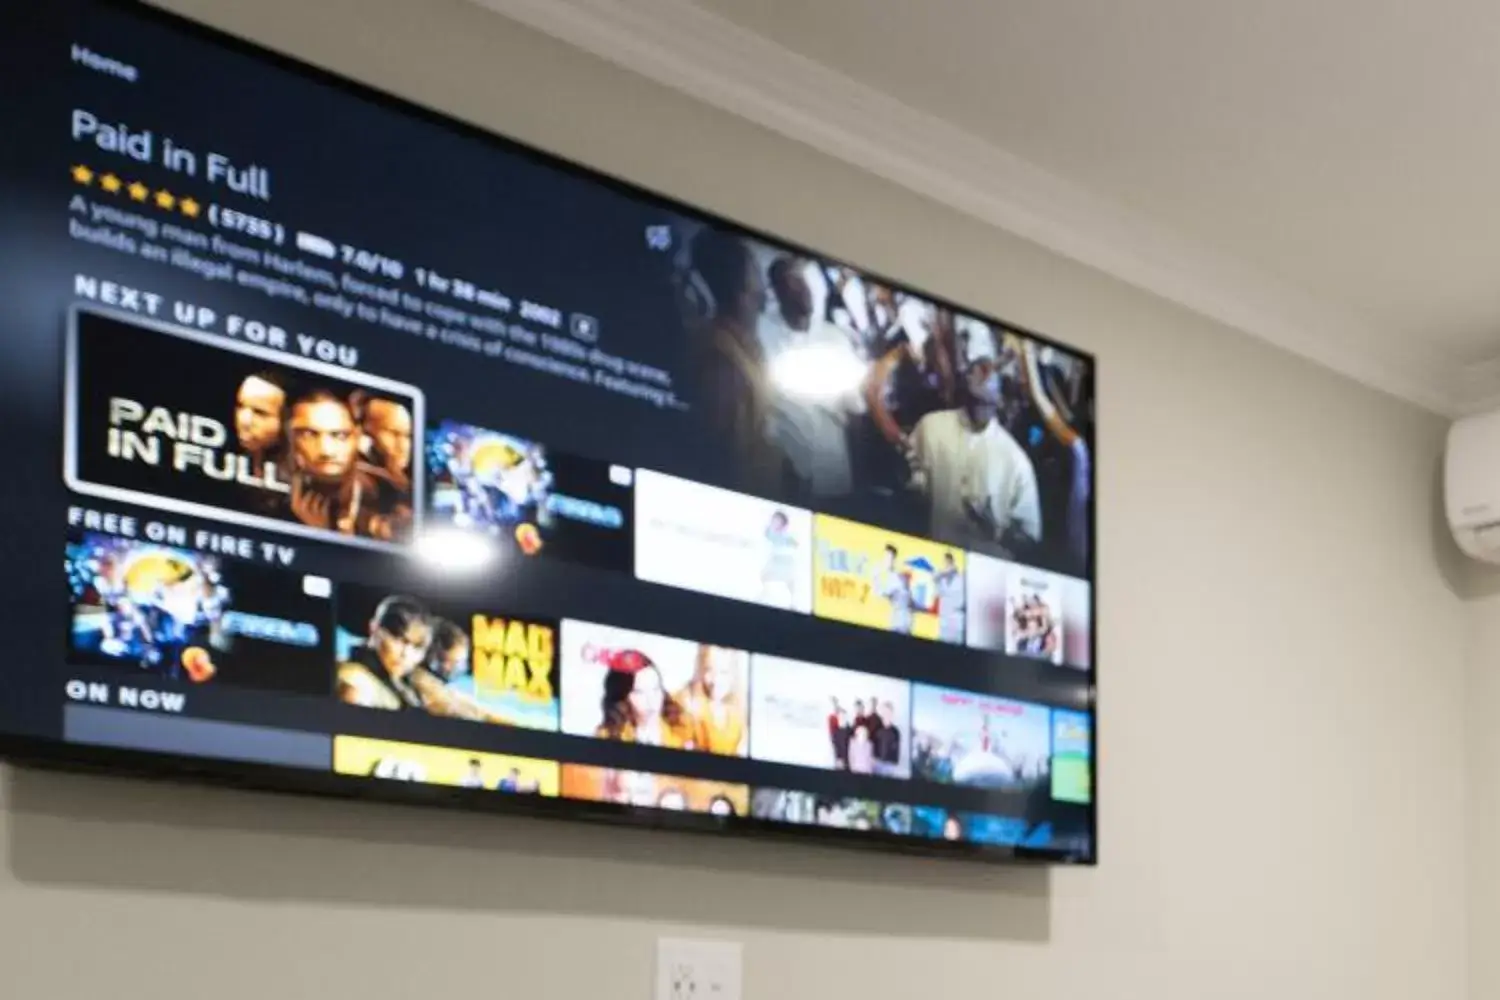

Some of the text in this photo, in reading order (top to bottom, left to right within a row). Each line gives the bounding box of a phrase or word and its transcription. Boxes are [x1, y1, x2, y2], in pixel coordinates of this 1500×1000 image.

[71, 44, 138, 82] Home
[71, 108, 271, 200] Paid in Full
[69, 194, 87, 214] A
[74, 273, 359, 367] NEXT UP FOR YOU
[108, 396, 228, 449] PAID
[107, 428, 291, 493] IN FULL
[67, 506, 297, 566] FREE ON FIRE TV
[472, 613, 553, 659] MAD
[65, 679, 188, 713] ON NOW
[472, 645, 553, 703] MAX
